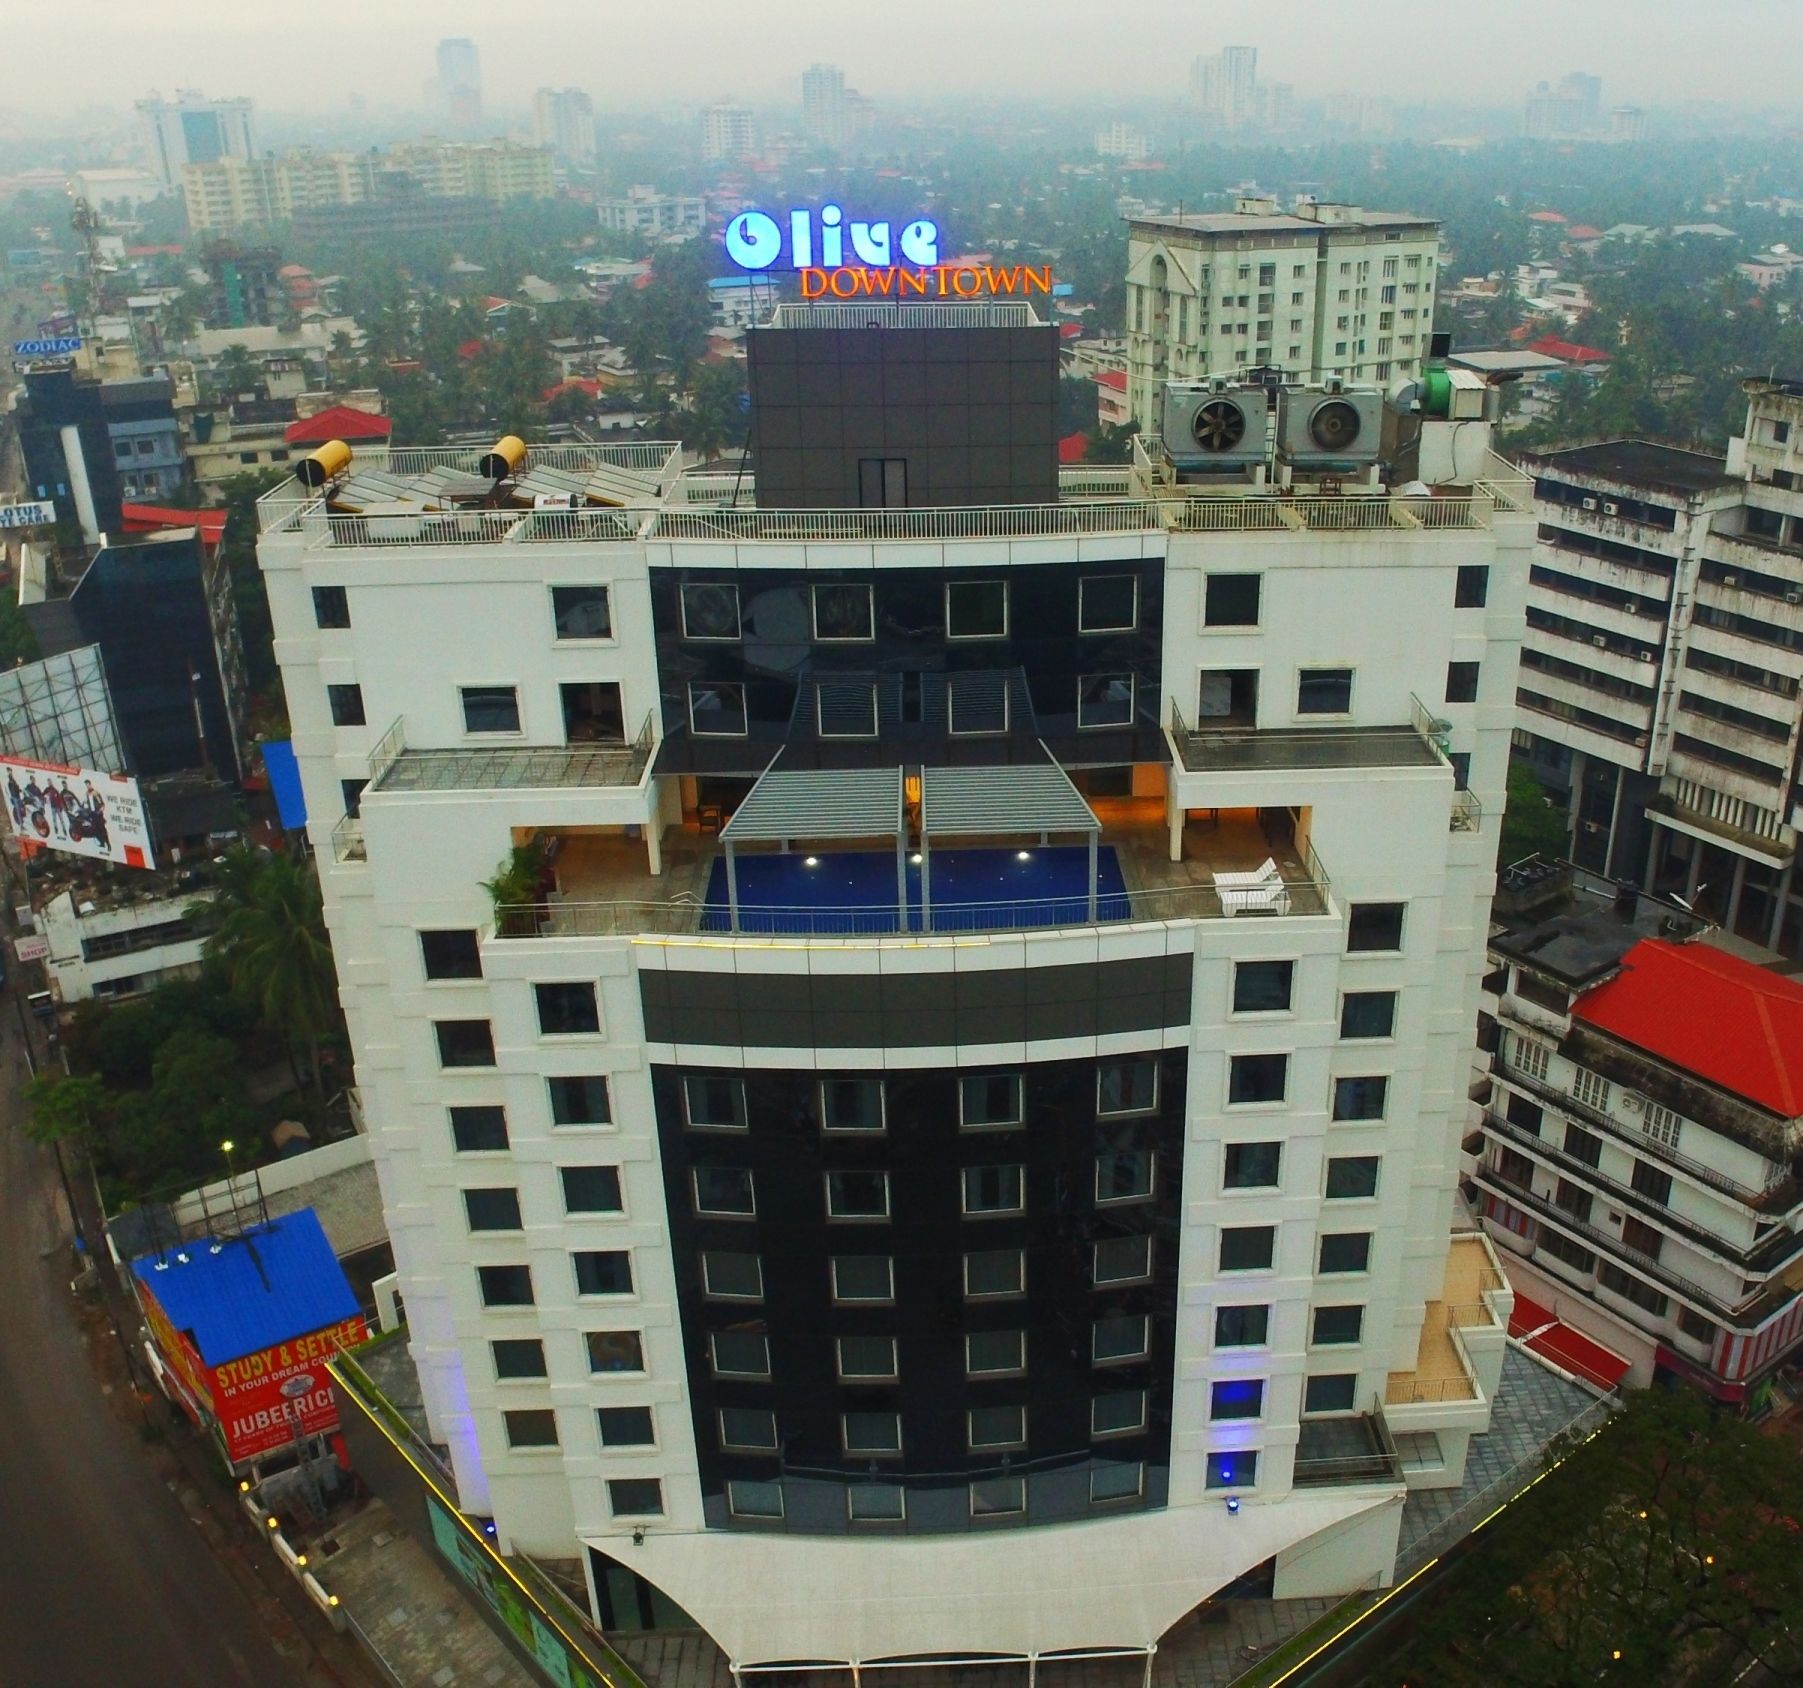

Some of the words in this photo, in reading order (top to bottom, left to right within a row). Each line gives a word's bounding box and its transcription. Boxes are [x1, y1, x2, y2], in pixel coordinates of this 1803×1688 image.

[725, 204, 938, 270] Olive
[800, 264, 1052, 298] DOWNTOWN
[16, 338, 80, 354] ZODIAC
[116, 805, 133, 815] KTM
[216, 1350, 274, 1389] STUDY
[279, 1345, 293, 1367] &
[296, 1320, 359, 1361] SETTLE
[224, 1386, 237, 1398] IN
[239, 1375, 270, 1393] YOUR
[272, 1361, 309, 1382] DREAM
